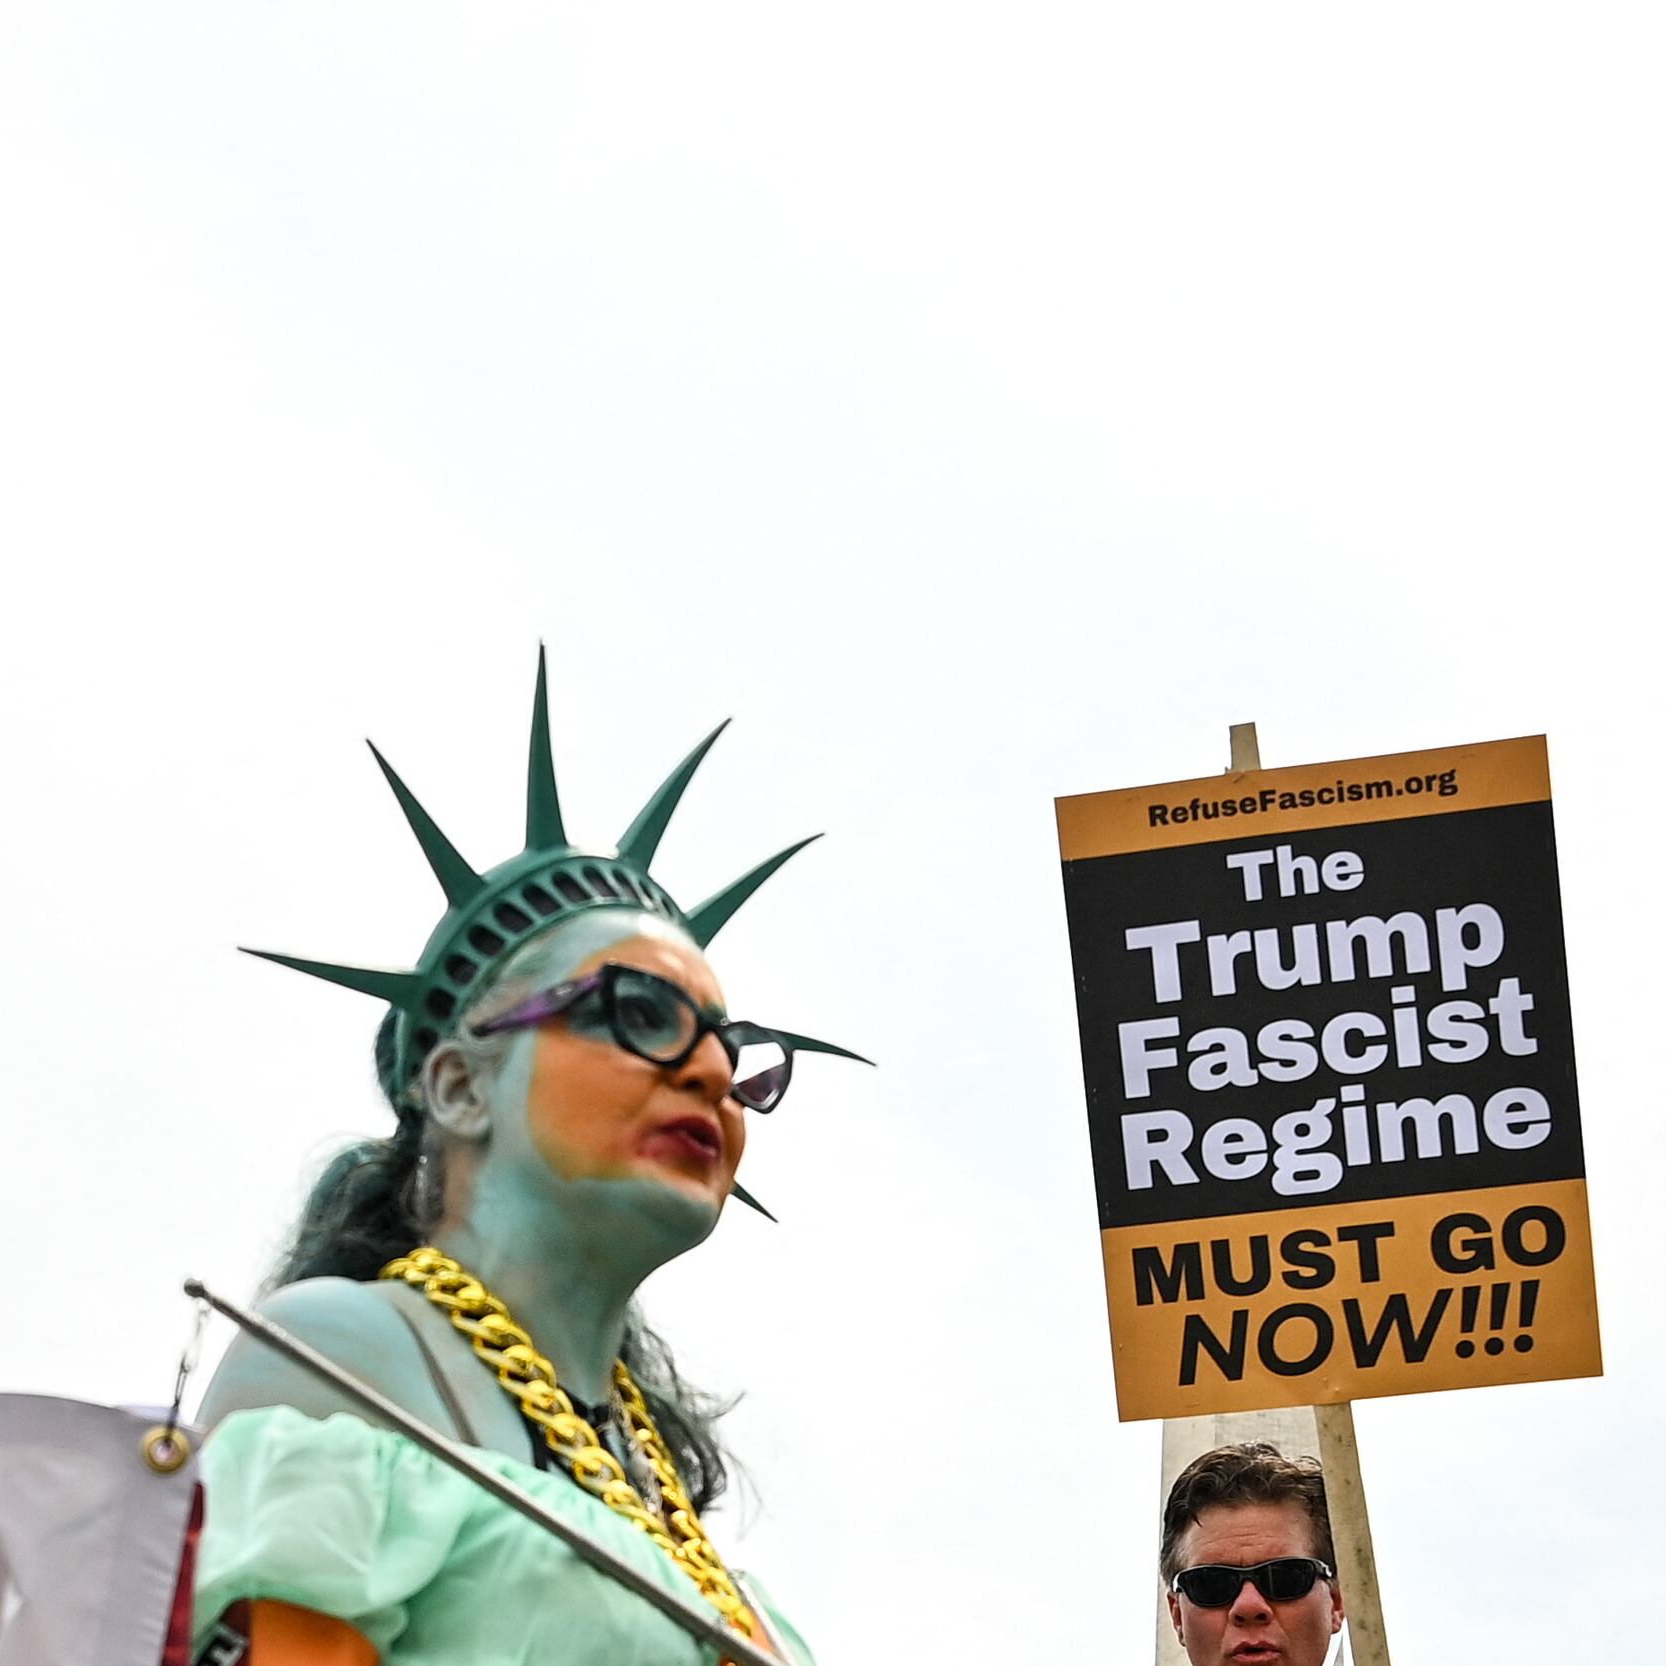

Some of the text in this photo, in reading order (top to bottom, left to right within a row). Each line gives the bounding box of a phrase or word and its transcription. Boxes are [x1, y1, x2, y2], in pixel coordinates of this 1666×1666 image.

[1147, 768, 1459, 828] RefuseFascism.org
[1226, 843, 1366, 901] The
[1125, 902, 1505, 1004] Trump
[1118, 977, 1538, 1100] Fascist
[1121, 1085, 1553, 1197] Regime
[1131, 1205, 1567, 1307] MUST GO
[1178, 1279, 1540, 1386] NOW!!!
